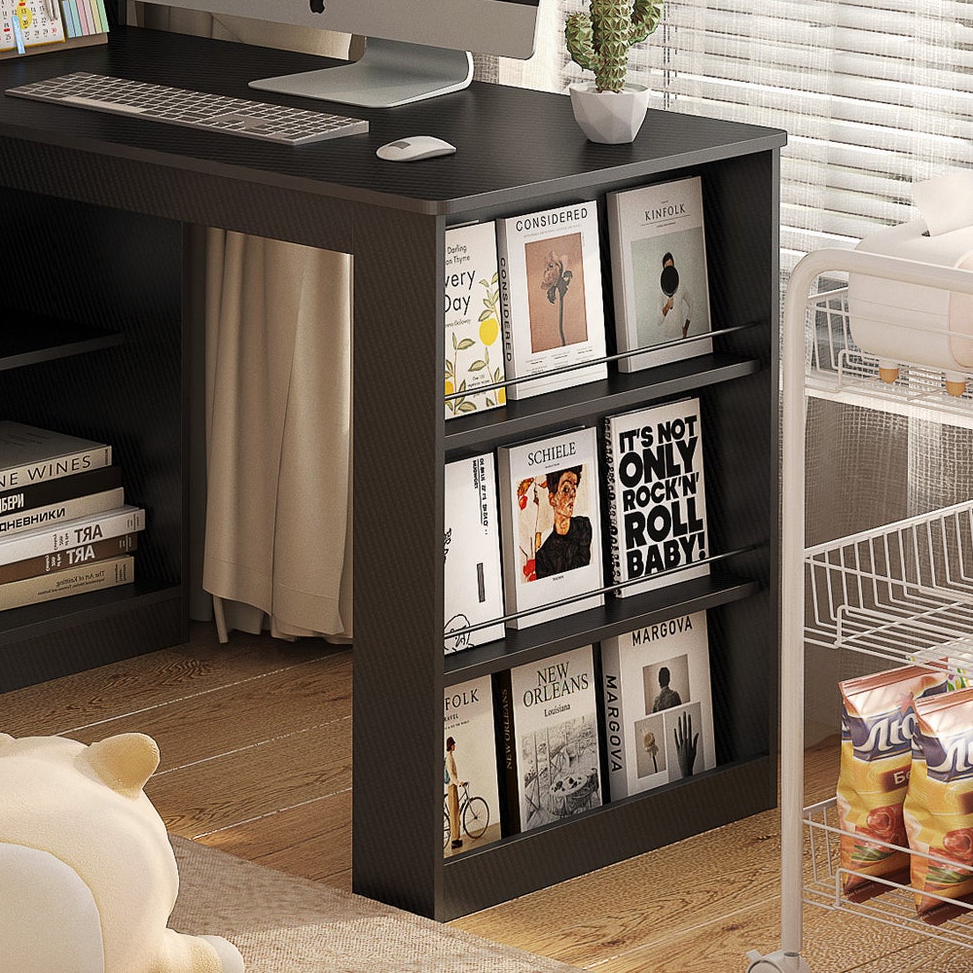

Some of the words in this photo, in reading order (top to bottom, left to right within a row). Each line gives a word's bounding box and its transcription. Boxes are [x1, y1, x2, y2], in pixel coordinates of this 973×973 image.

[515, 207, 588, 232] CONSIDERED
[645, 203, 686, 221] KINFOLK
[500, 257, 512, 362] CONSIDERED
[618, 425, 654, 454] IT'S
[657, 415, 698, 445] NOT
[28, 454, 92, 481] WINES
[527, 441, 577, 467] SCHIELE
[618, 437, 698, 488] ONLY
[624, 497, 704, 550] ROLL
[626, 531, 707, 579] BABY!
[631, 615, 693, 647] MARGOVA
[523, 673, 589, 708] ORLEANS
[537, 662, 570, 687] NEW
[445, 688, 479, 711] FOLK
[501, 689, 513, 742] ORLEANS
[544, 703, 571, 718] Louisiana
[605, 674, 623, 772] MARGOVA
